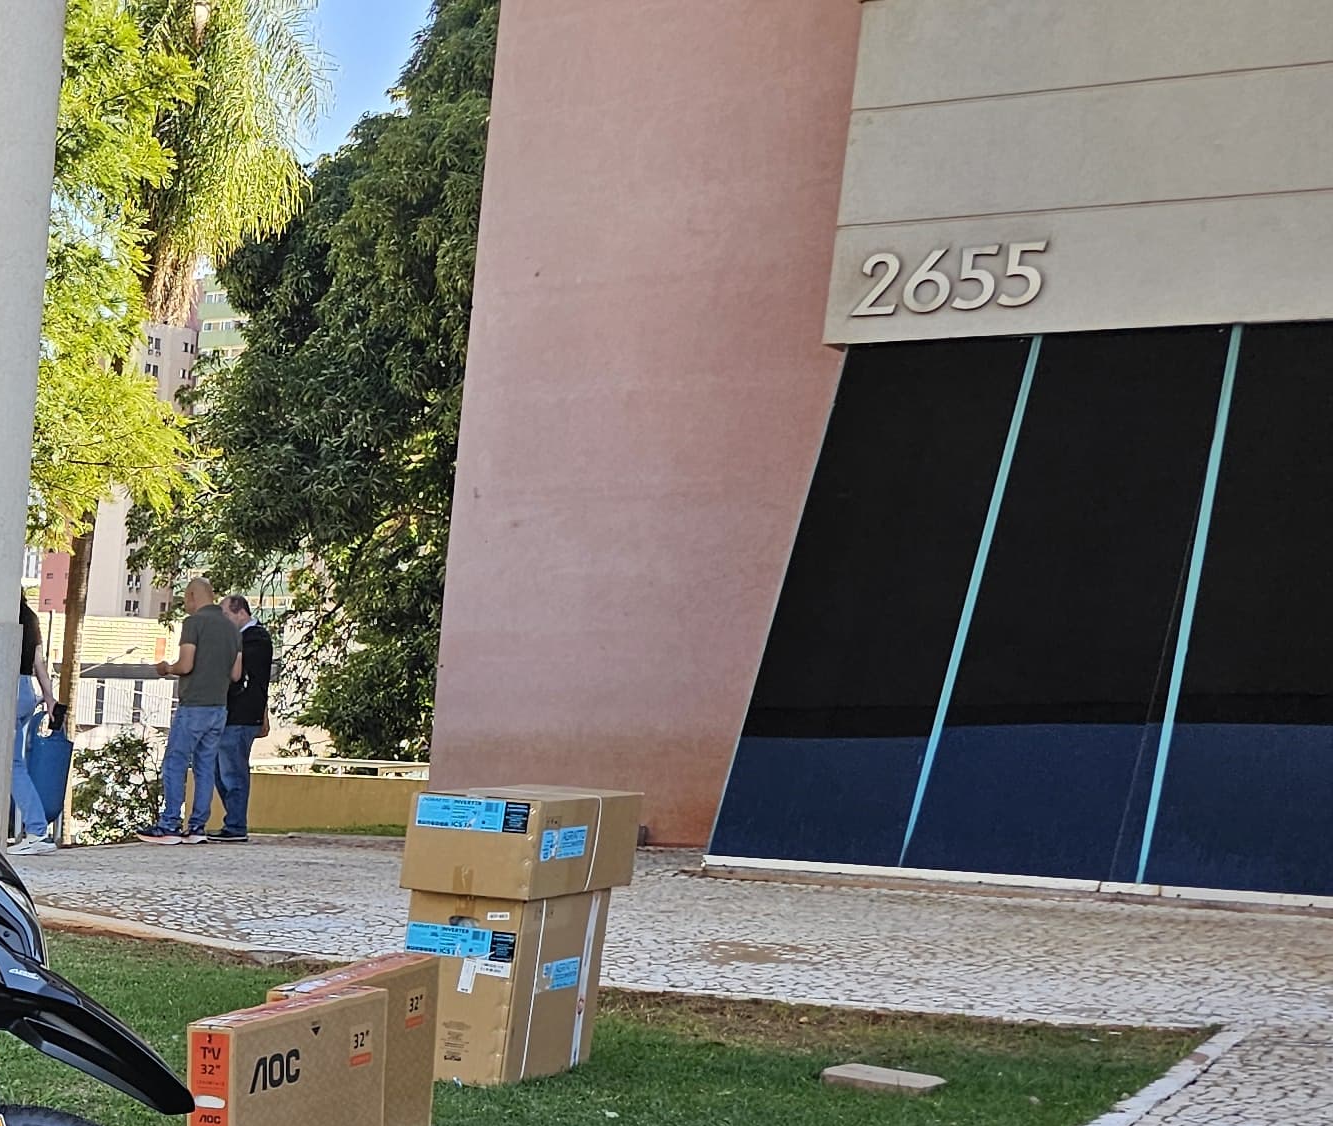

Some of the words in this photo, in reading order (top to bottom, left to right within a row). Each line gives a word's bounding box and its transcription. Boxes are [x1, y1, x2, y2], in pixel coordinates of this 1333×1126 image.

[850, 239, 1049, 317] 2655
[353, 1029, 370, 1049] 32"
[200, 1064, 221, 1075] 32"
[249, 1048, 301, 1094] AOC
[199, 1115, 221, 1125] AOC
